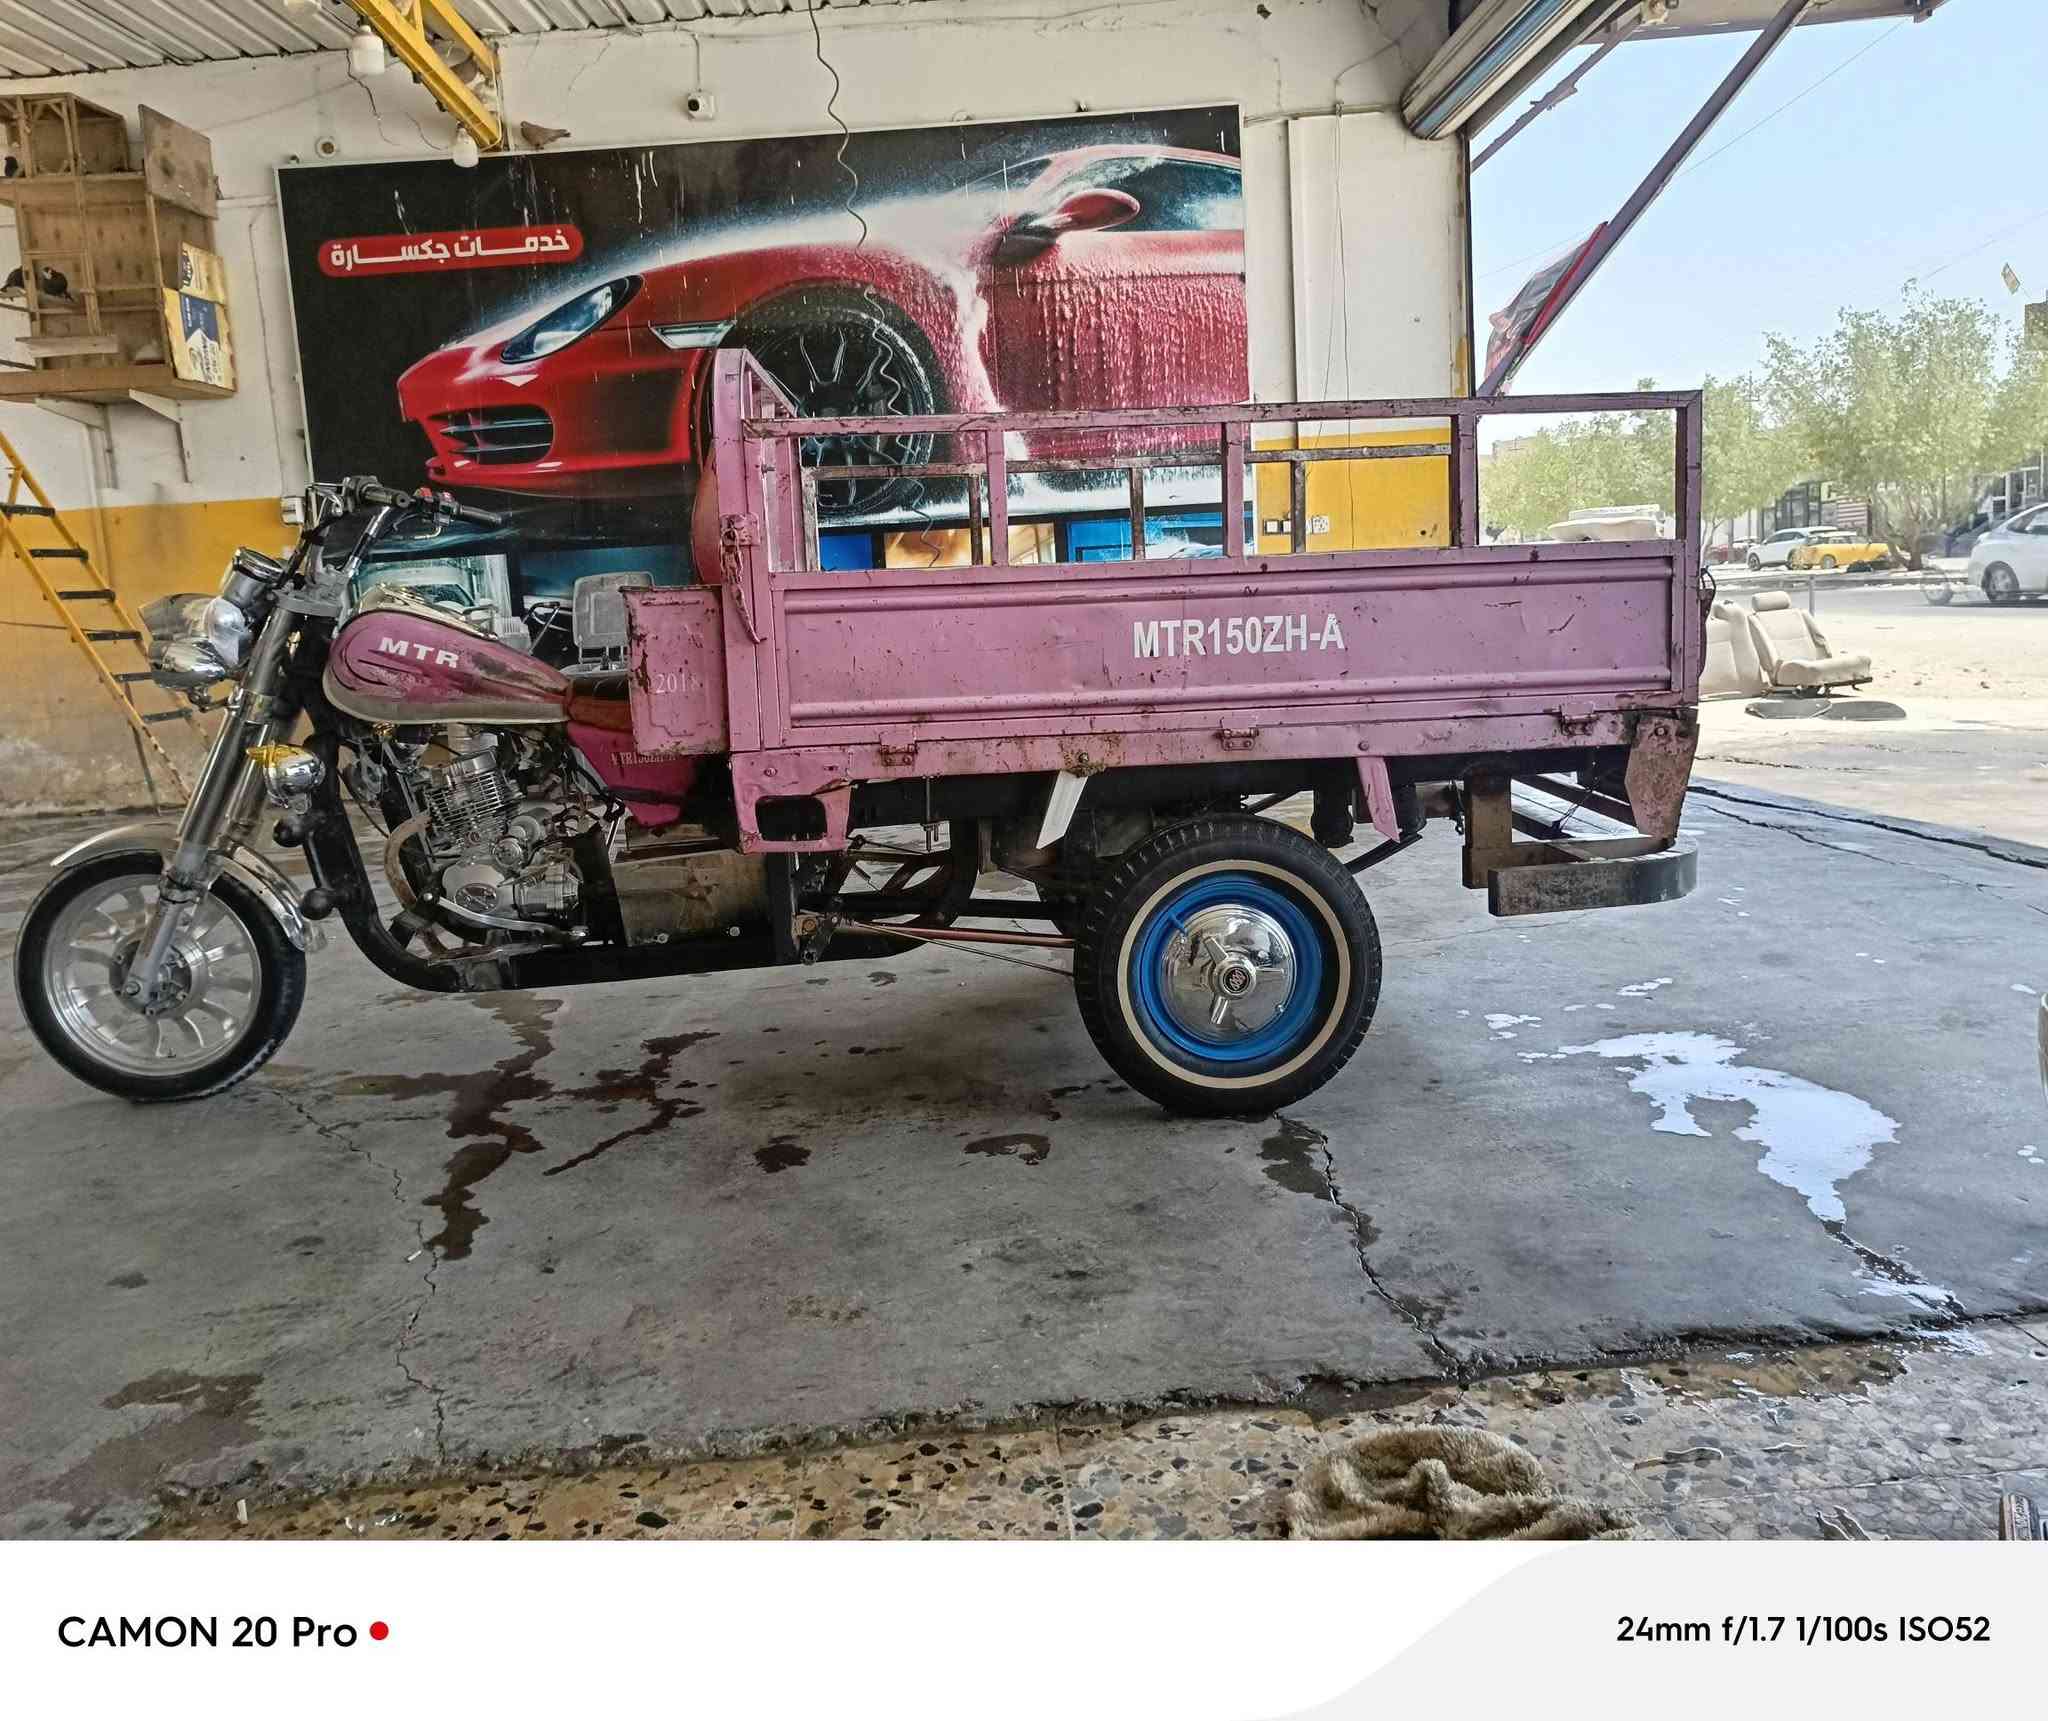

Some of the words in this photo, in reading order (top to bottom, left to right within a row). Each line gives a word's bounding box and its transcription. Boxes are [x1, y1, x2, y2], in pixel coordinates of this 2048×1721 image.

[330, 239, 451, 271] جكسارة
[453, 229, 570, 258] خدمات
[1133, 613, 1346, 659] MTR150ZH-A
[379, 637, 460, 669] MTR
